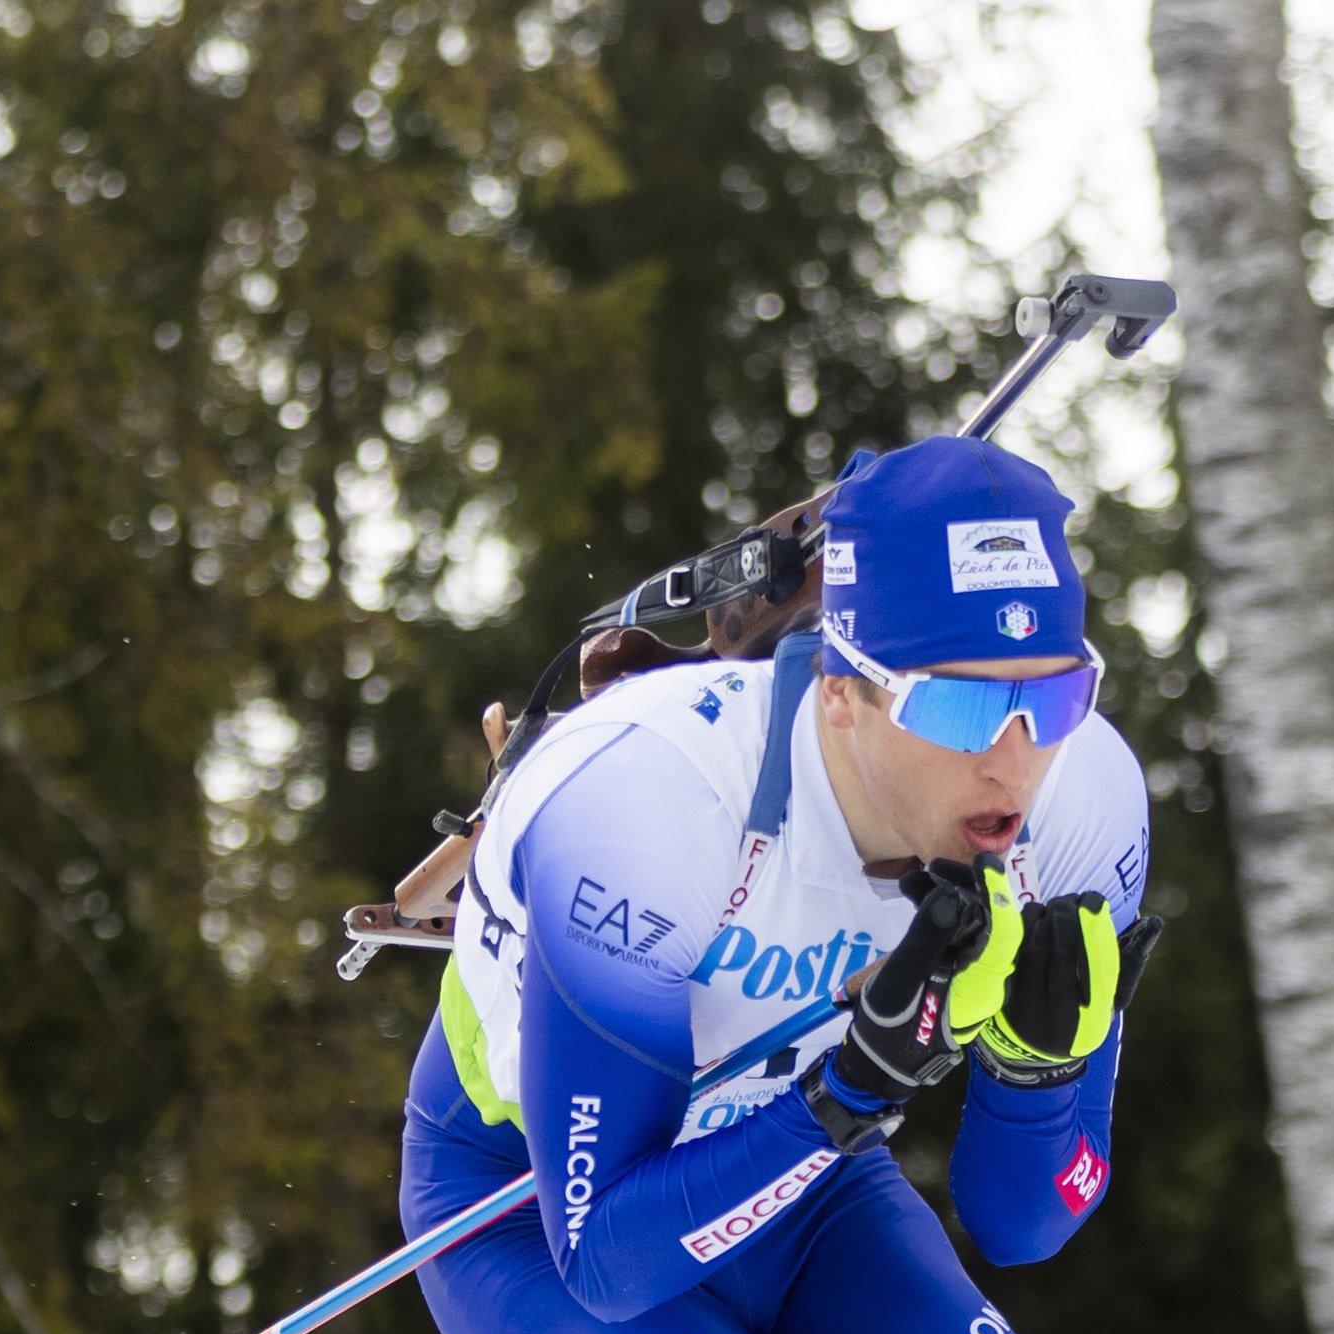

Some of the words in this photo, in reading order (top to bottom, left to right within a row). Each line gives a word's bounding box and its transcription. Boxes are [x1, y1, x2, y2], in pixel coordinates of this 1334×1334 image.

[566, 925, 607, 954] EMPORIO
[618, 948, 660, 971] ARMANI
[569, 876, 677, 954] EA7
[689, 1154, 833, 1258] FIOCCHI
